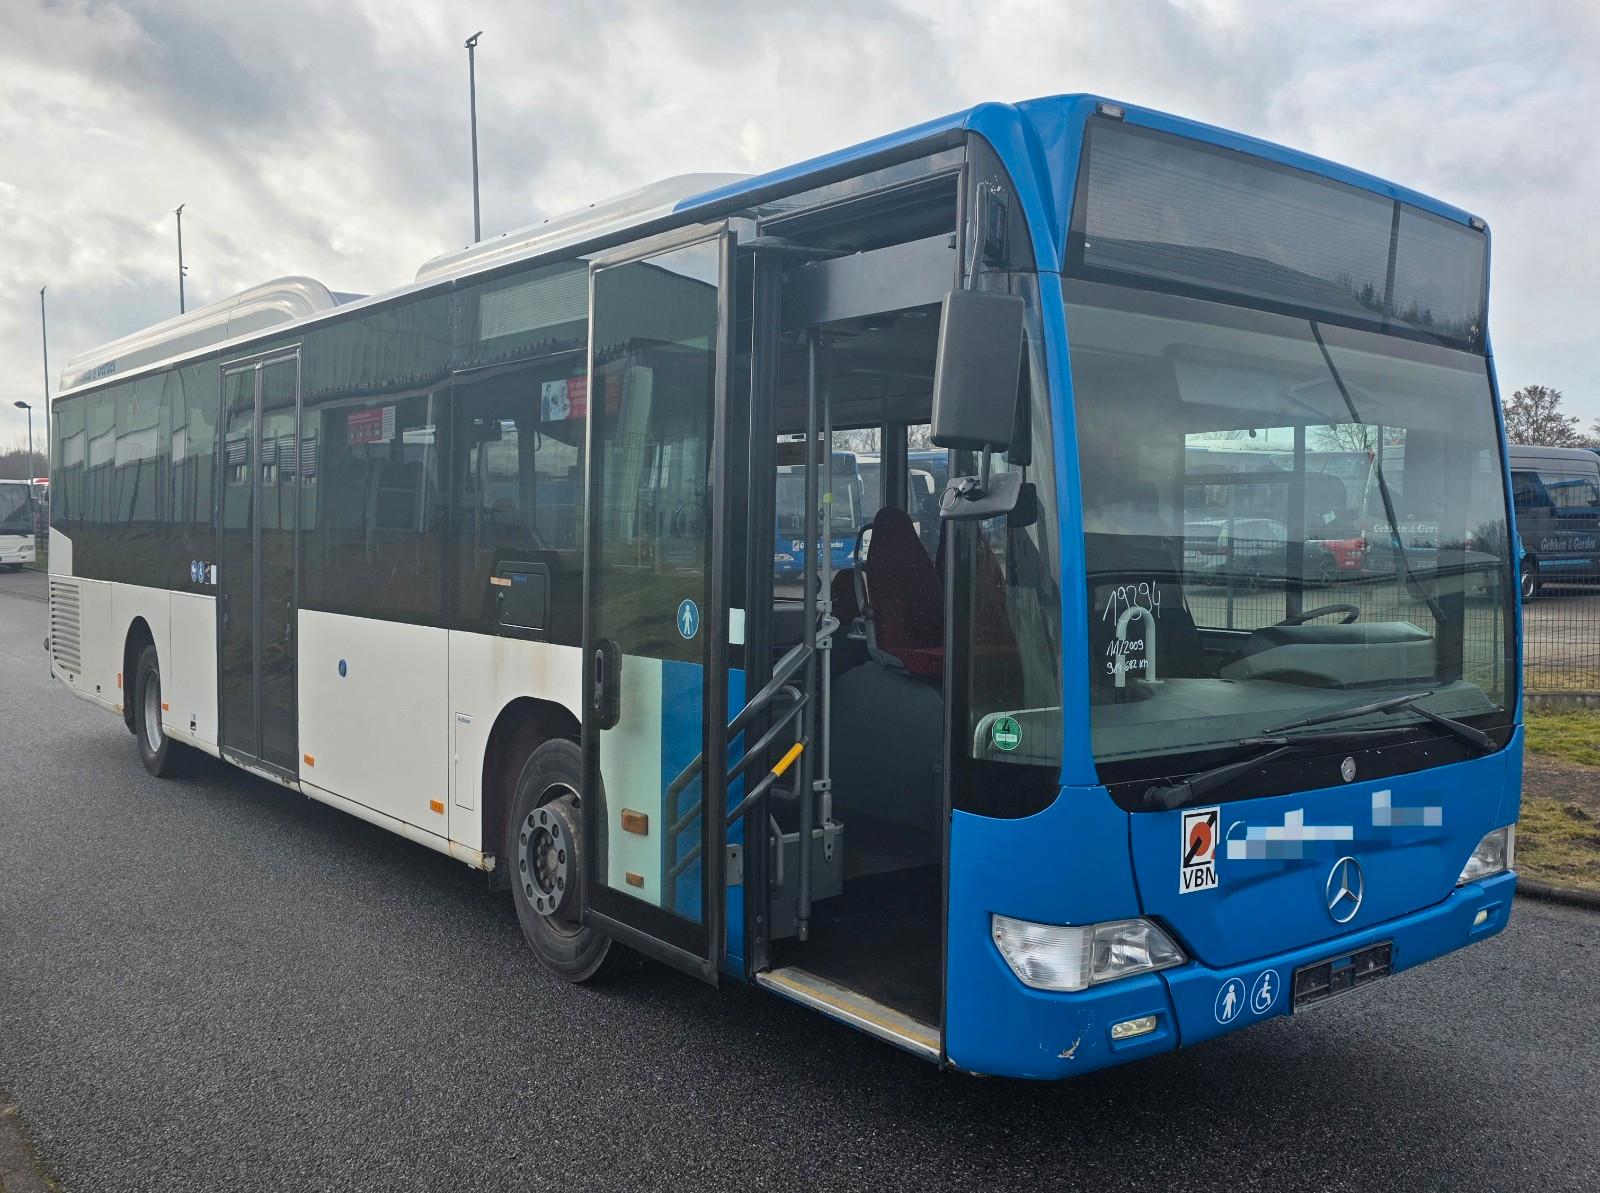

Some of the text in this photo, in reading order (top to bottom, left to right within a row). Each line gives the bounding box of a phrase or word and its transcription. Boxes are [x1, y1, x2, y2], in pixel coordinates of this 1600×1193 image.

[1106, 640, 1144, 656] 11/2009
[1002, 719, 1011, 734] 4
[1183, 867, 1216, 890] VBN
